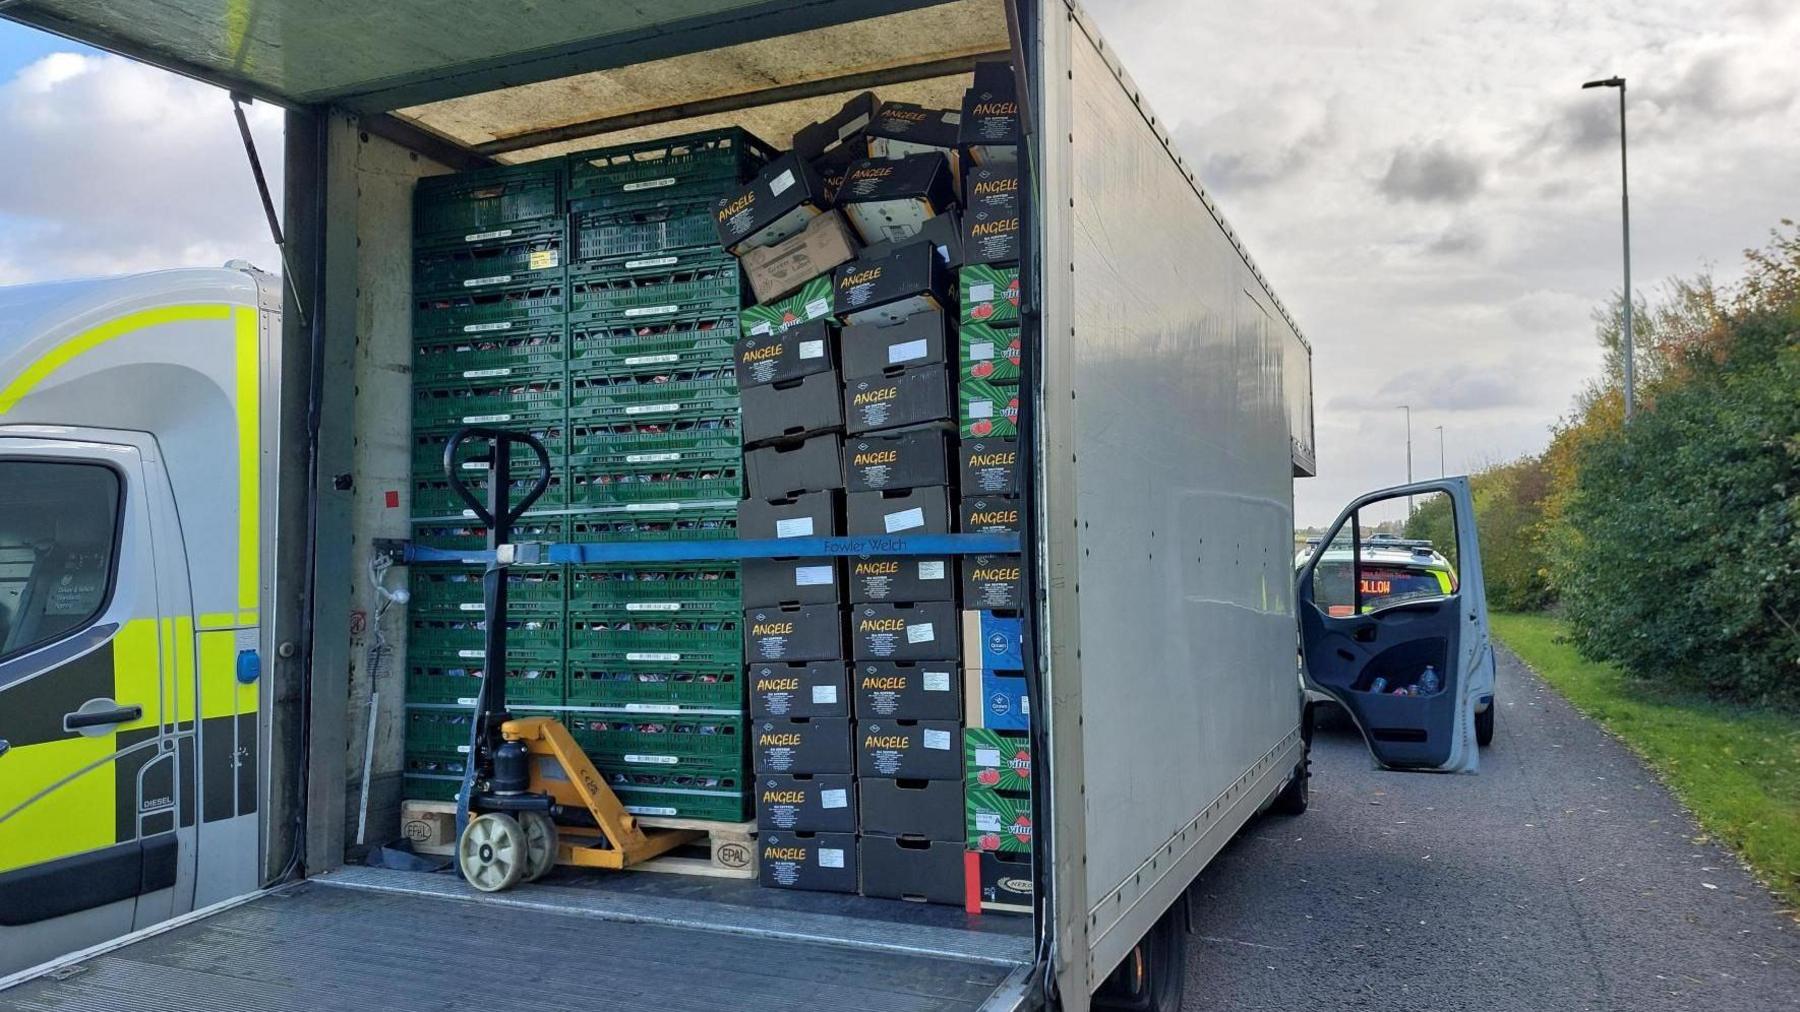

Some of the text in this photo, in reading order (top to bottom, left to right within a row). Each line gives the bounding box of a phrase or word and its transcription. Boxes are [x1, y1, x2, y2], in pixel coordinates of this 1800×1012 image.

[882, 109, 927, 121] ANGELE
[851, 166, 894, 179] ANGELE
[719, 191, 756, 222] ANGELE
[972, 217, 1019, 237] ANGELE
[840, 267, 881, 288] ANGELE
[743, 343, 783, 363] ANGELE
[854, 386, 897, 406] ANGELE
[854, 450, 897, 466] ANGELE
[969, 452, 1015, 468] ANGELE
[970, 511, 1018, 525] ANGELE
[824, 538, 907, 552] Fowler Welch
[855, 562, 899, 575] ANGELE
[972, 568, 1020, 582] ANGELE
[1361, 580, 1391, 593] OLLOW
[752, 622, 793, 636] ANGELE
[860, 619, 904, 632] ANGELE
[757, 678, 799, 692] ANGELE
[862, 677, 907, 690] ANGELE
[759, 733, 801, 747] ANGELE
[865, 736, 910, 749] ANGELE
[144, 796, 171, 808] DIESEL
[763, 791, 805, 804] ANGELE
[722, 848, 747, 863] EPAL
[764, 847, 806, 861] ANGELE
